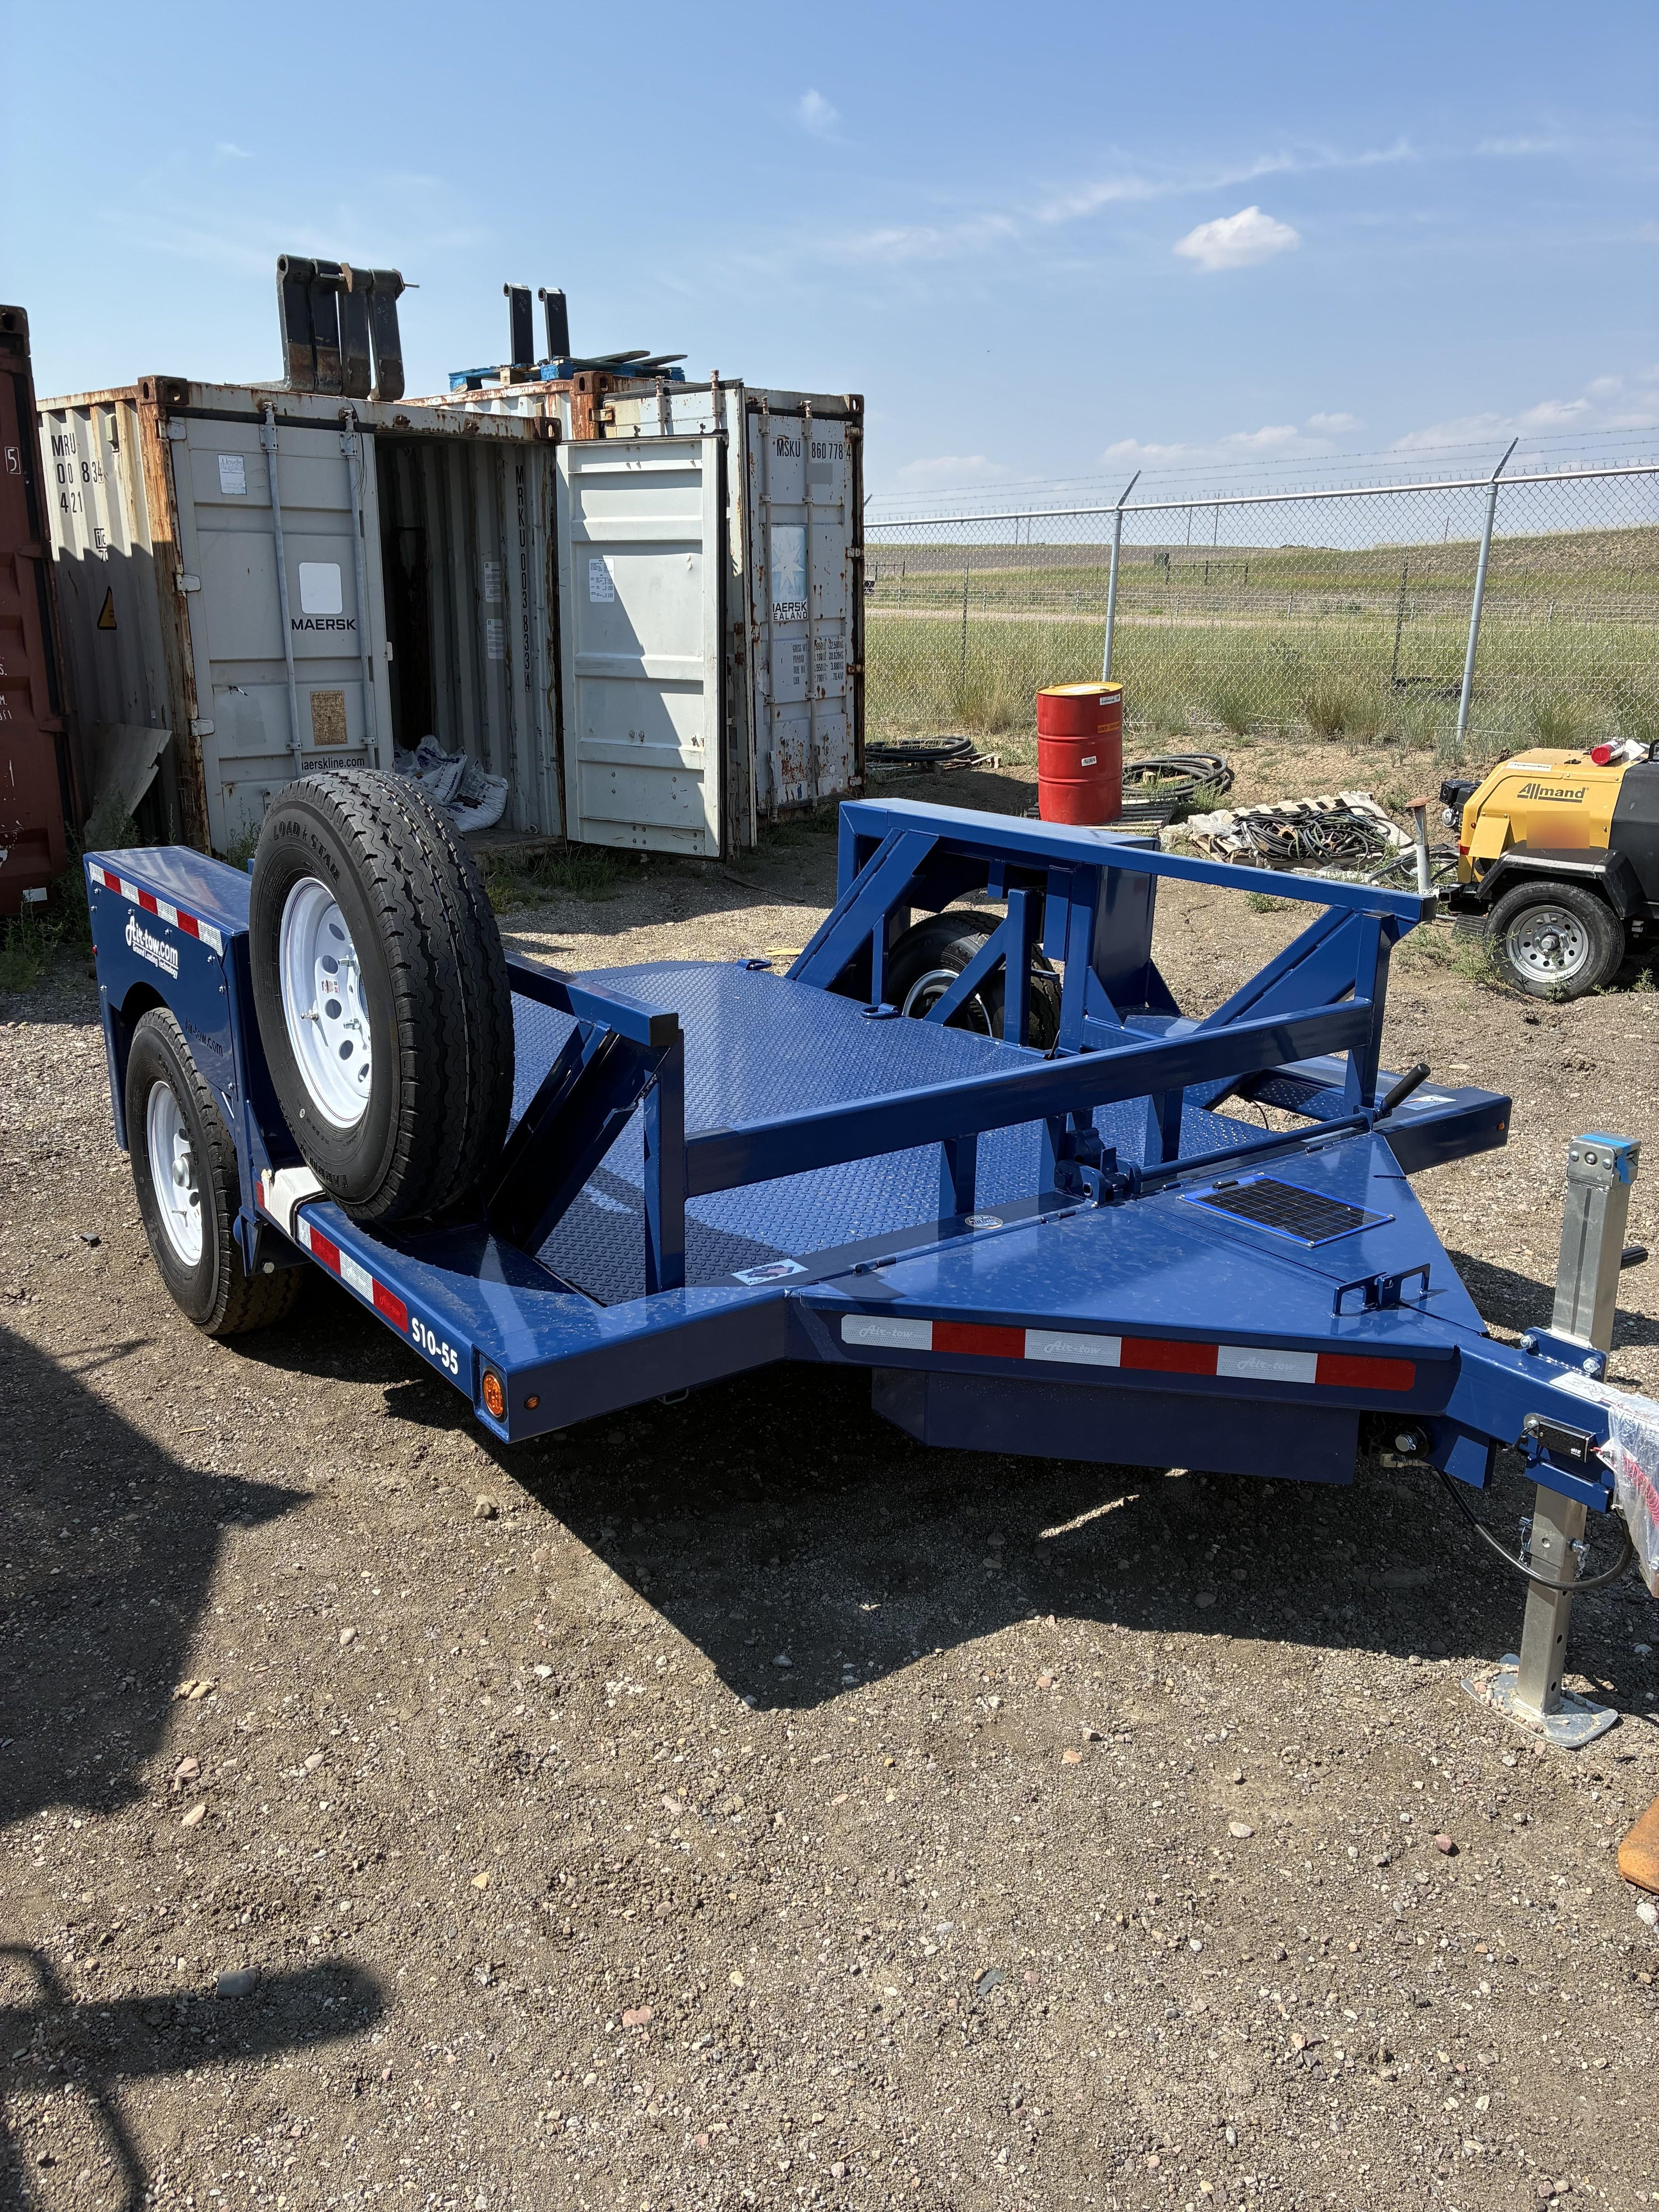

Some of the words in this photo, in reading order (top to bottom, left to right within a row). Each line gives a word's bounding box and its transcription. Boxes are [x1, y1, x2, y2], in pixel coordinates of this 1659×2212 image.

[777, 439, 800, 457] MSKU
[773, 602, 807, 612] AERSK
[773, 612, 808, 620] EALAND
[291, 619, 356, 630] MAERSK
[302, 757, 365, 770] aerskline.com
[1518, 783, 1586, 800] Allmand
[273, 821, 300, 841] LOAD
[309, 834, 340, 885] STAR
[126, 915, 178, 966] Air-tow.com
[158, 958, 178, 980] Technology
[186, 1018, 223, 1058] Air-tow.com
[412, 1317, 458, 1375] S10-55
